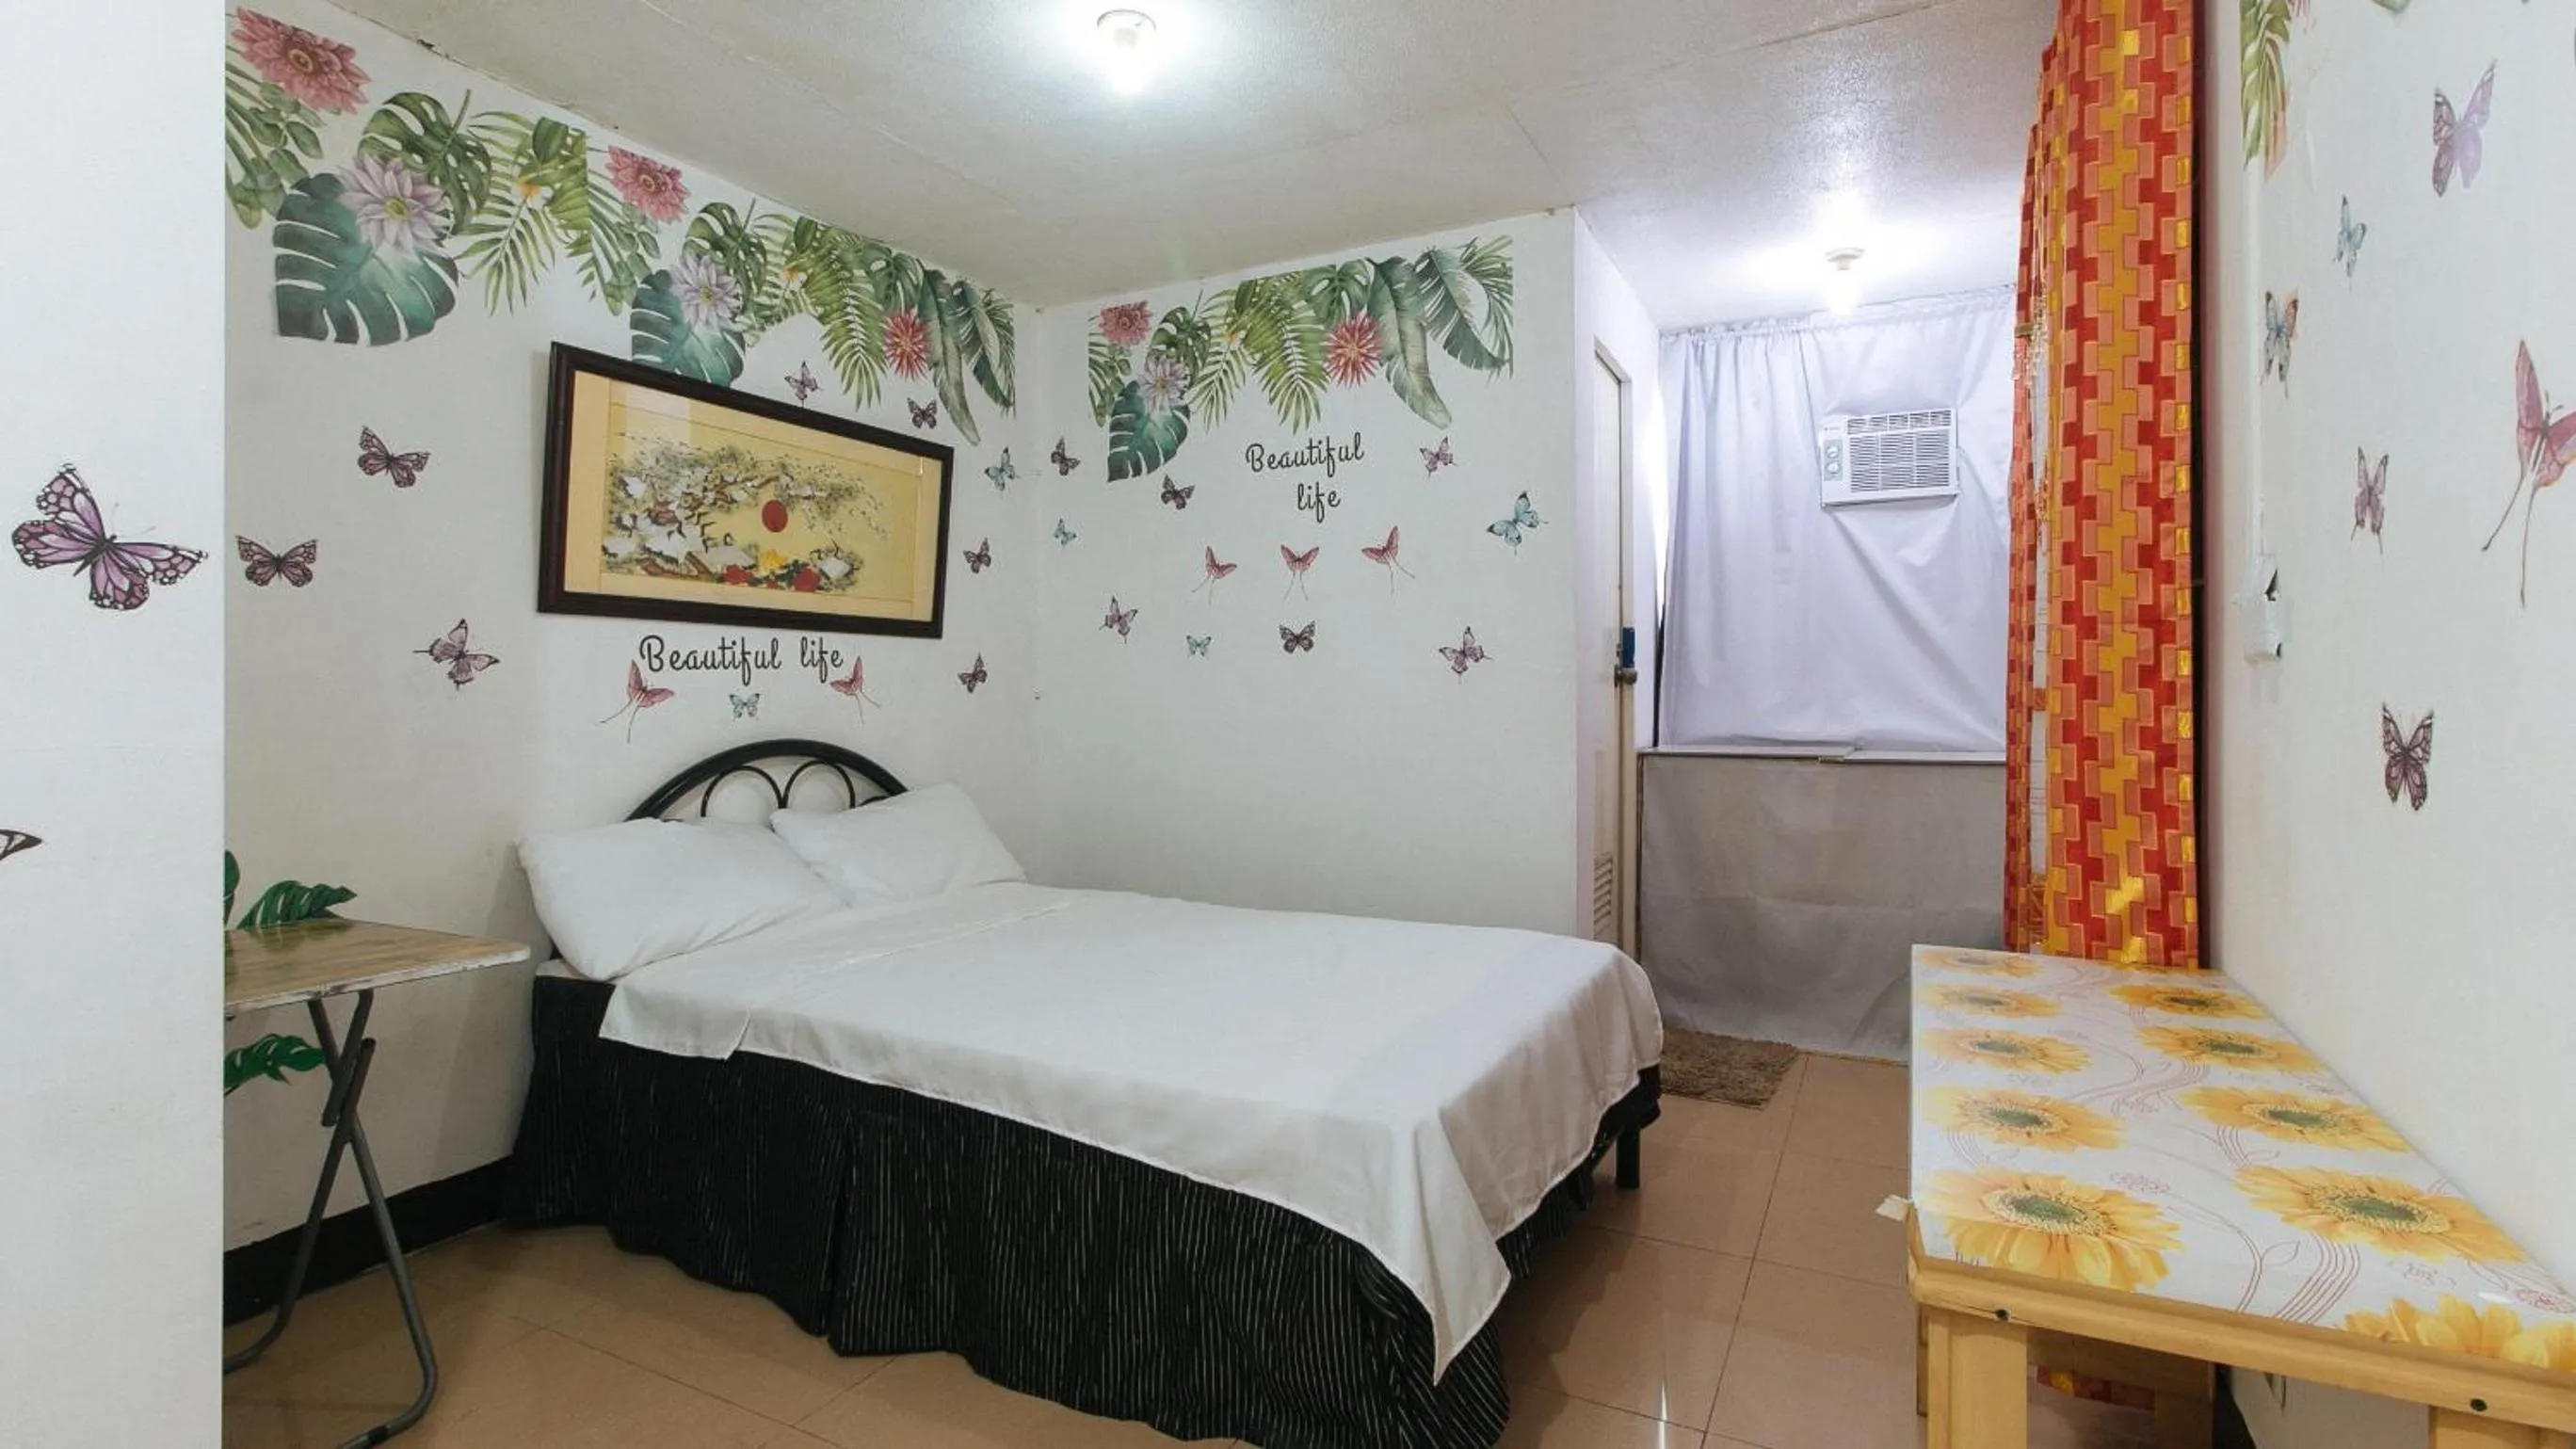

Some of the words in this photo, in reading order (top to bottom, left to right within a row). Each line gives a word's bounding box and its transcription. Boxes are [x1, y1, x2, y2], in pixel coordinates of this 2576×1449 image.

[1245, 431, 1364, 478] Beautiful
[1297, 482, 1341, 523] life
[639, 635, 781, 686] Beautiful
[800, 636, 844, 684] life
